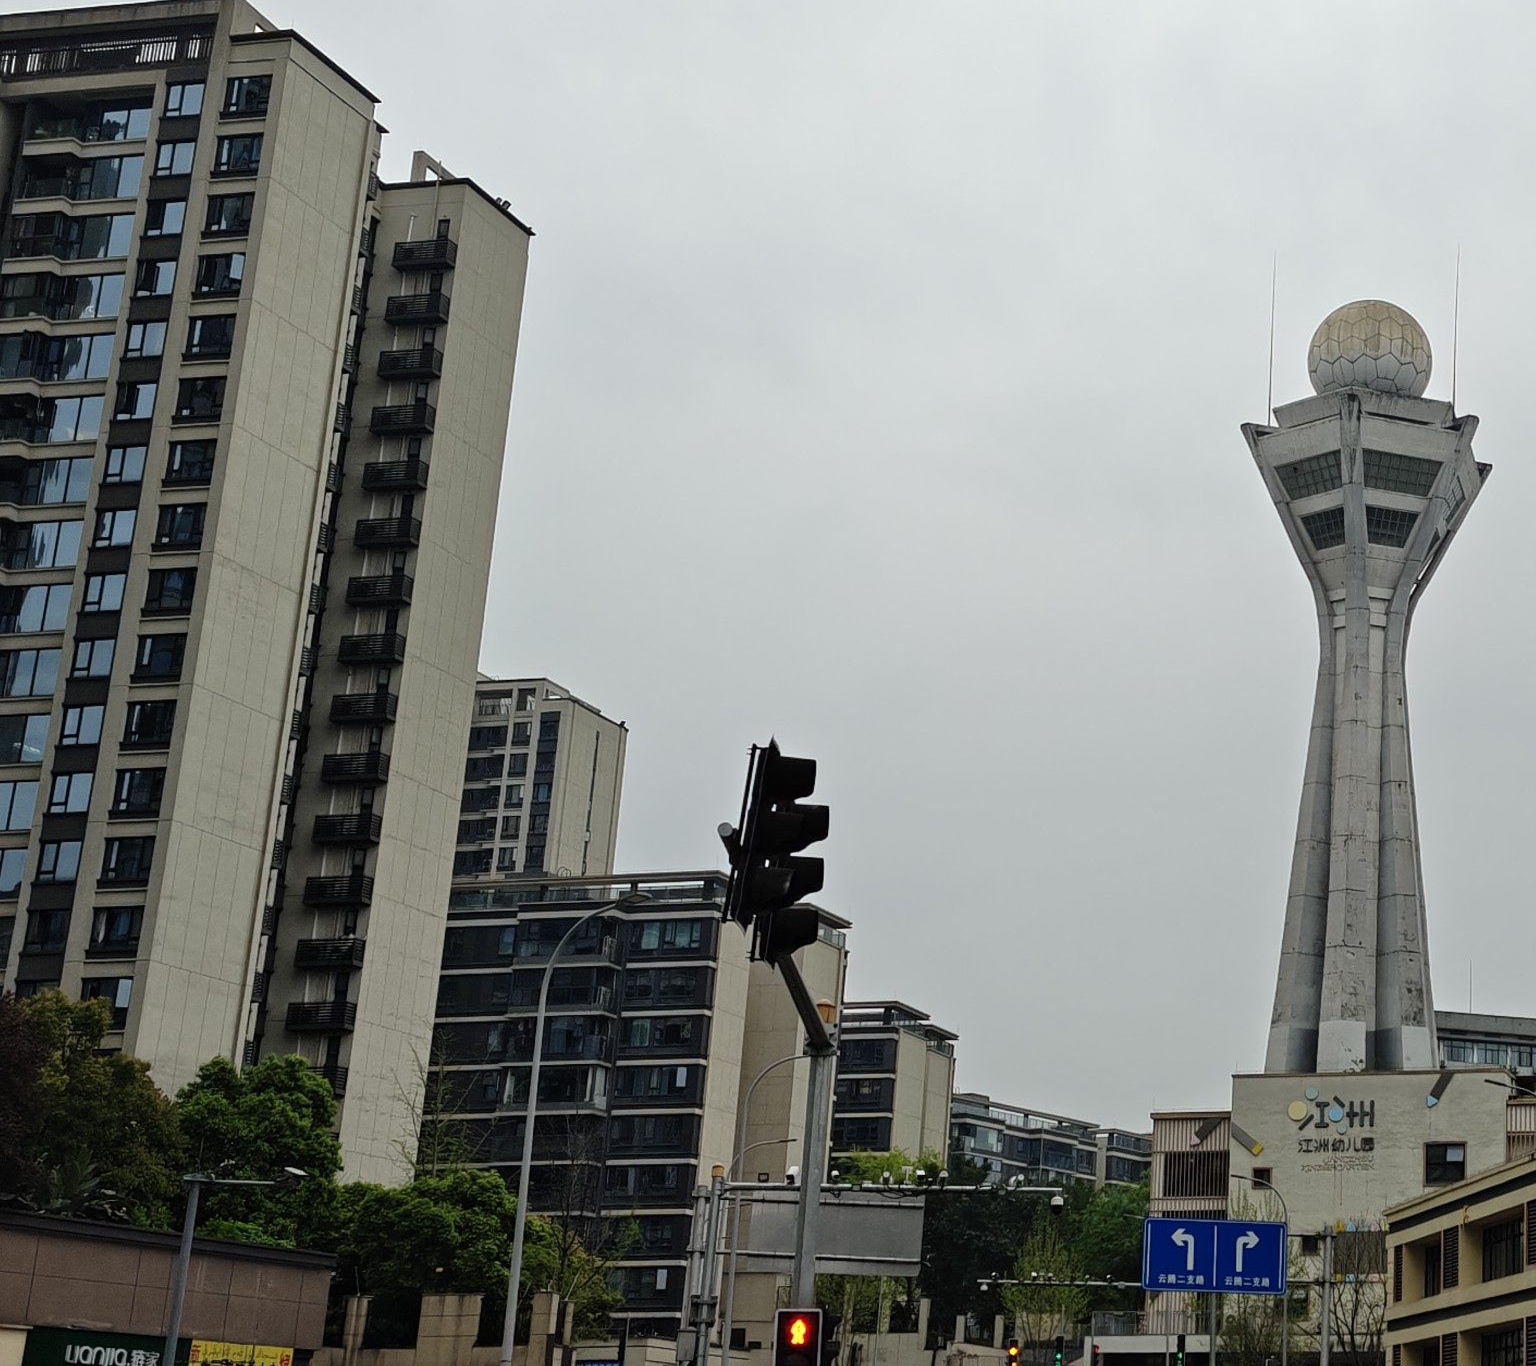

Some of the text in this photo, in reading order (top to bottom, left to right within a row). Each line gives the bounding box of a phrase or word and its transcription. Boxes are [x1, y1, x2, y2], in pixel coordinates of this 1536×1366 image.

[1298, 1137, 1375, 1153] 江洲幼儿园
